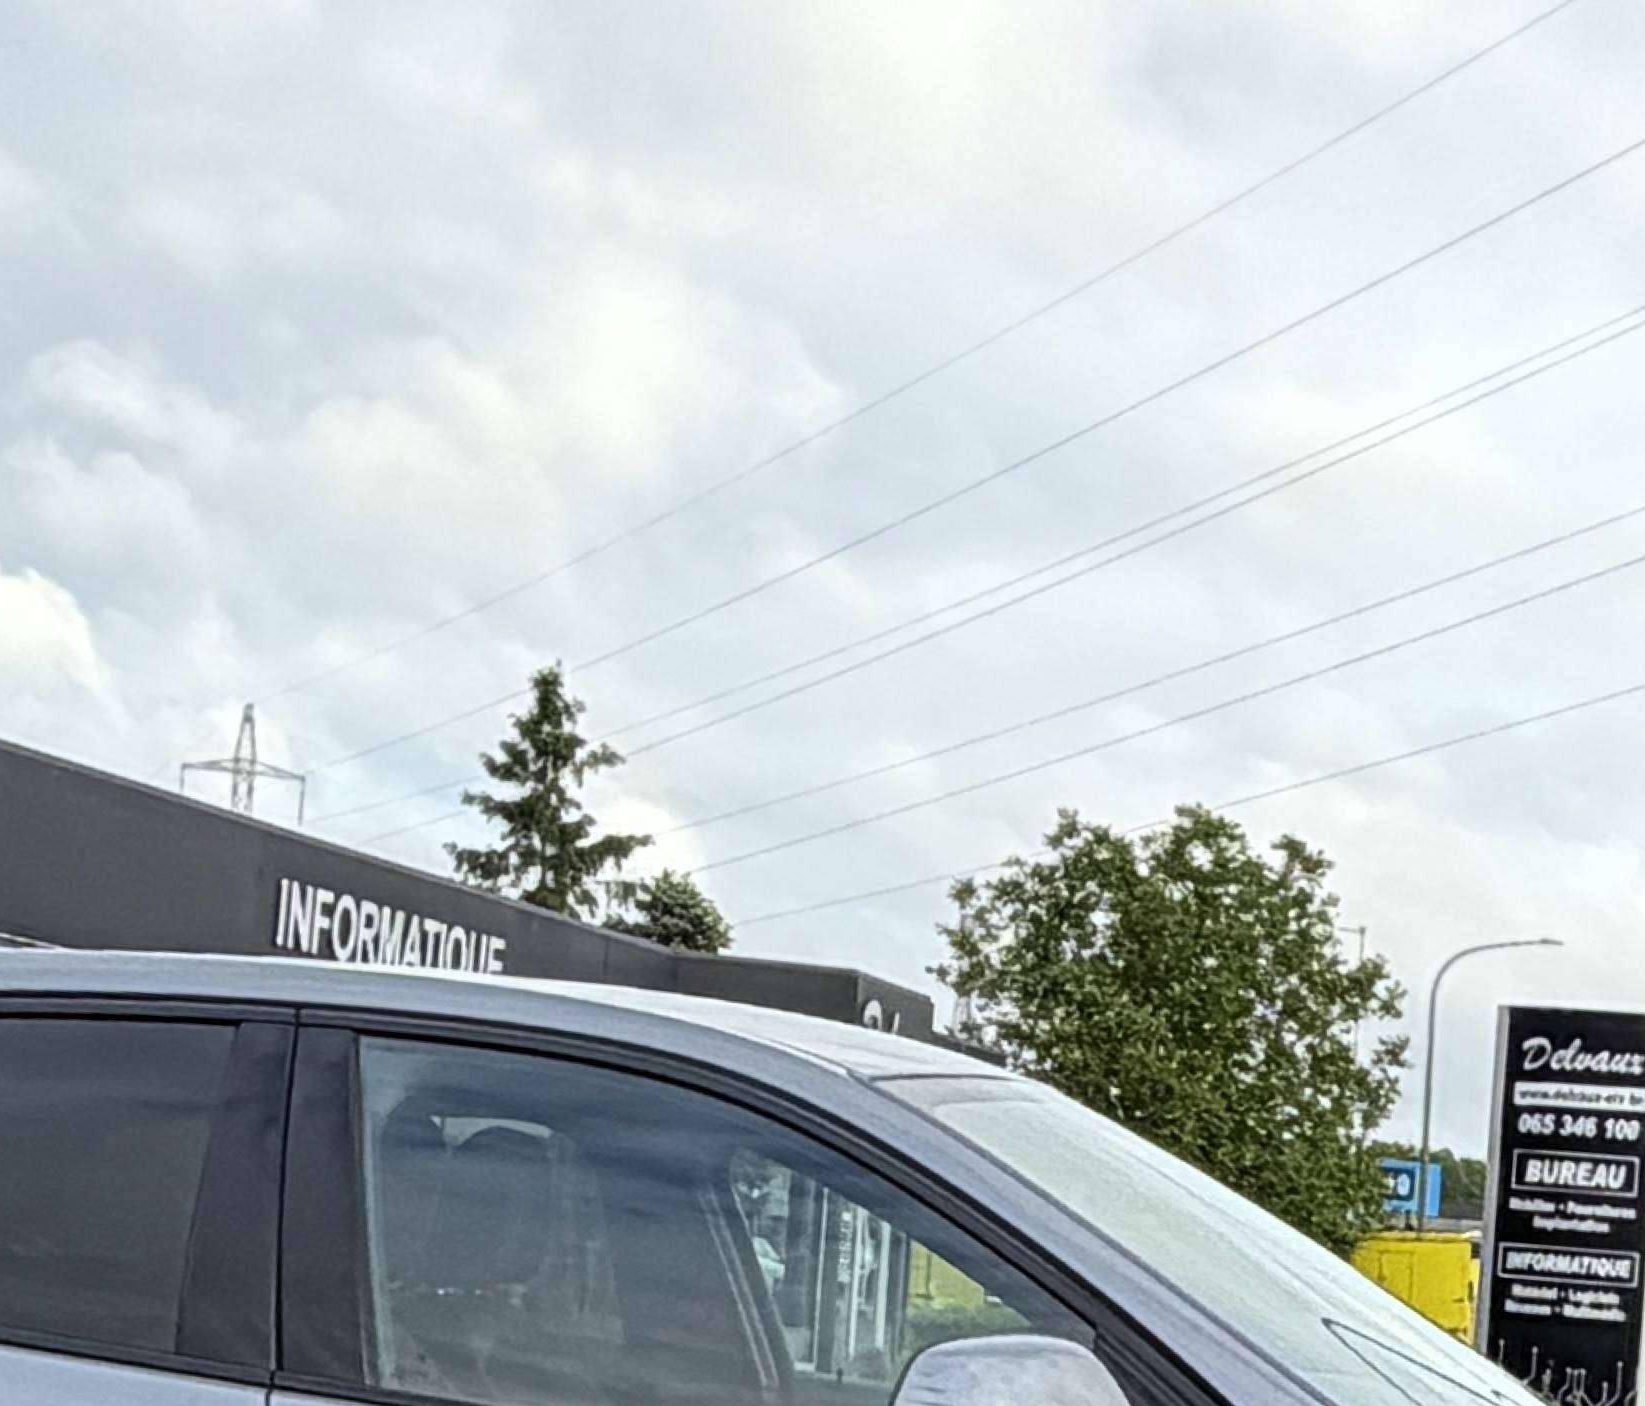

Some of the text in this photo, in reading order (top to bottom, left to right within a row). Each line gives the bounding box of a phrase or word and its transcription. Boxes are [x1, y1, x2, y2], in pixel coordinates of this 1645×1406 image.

[276, 878, 506, 974] INFORMATIQUE
[1522, 1036, 1645, 1075] Delvaux
[1518, 1112, 1555, 1135] 065
[1605, 1117, 1640, 1141] 100
[1524, 1158, 1627, 1189] BUREAU
[1506, 1251, 1631, 1278] INFORMATIQUE
